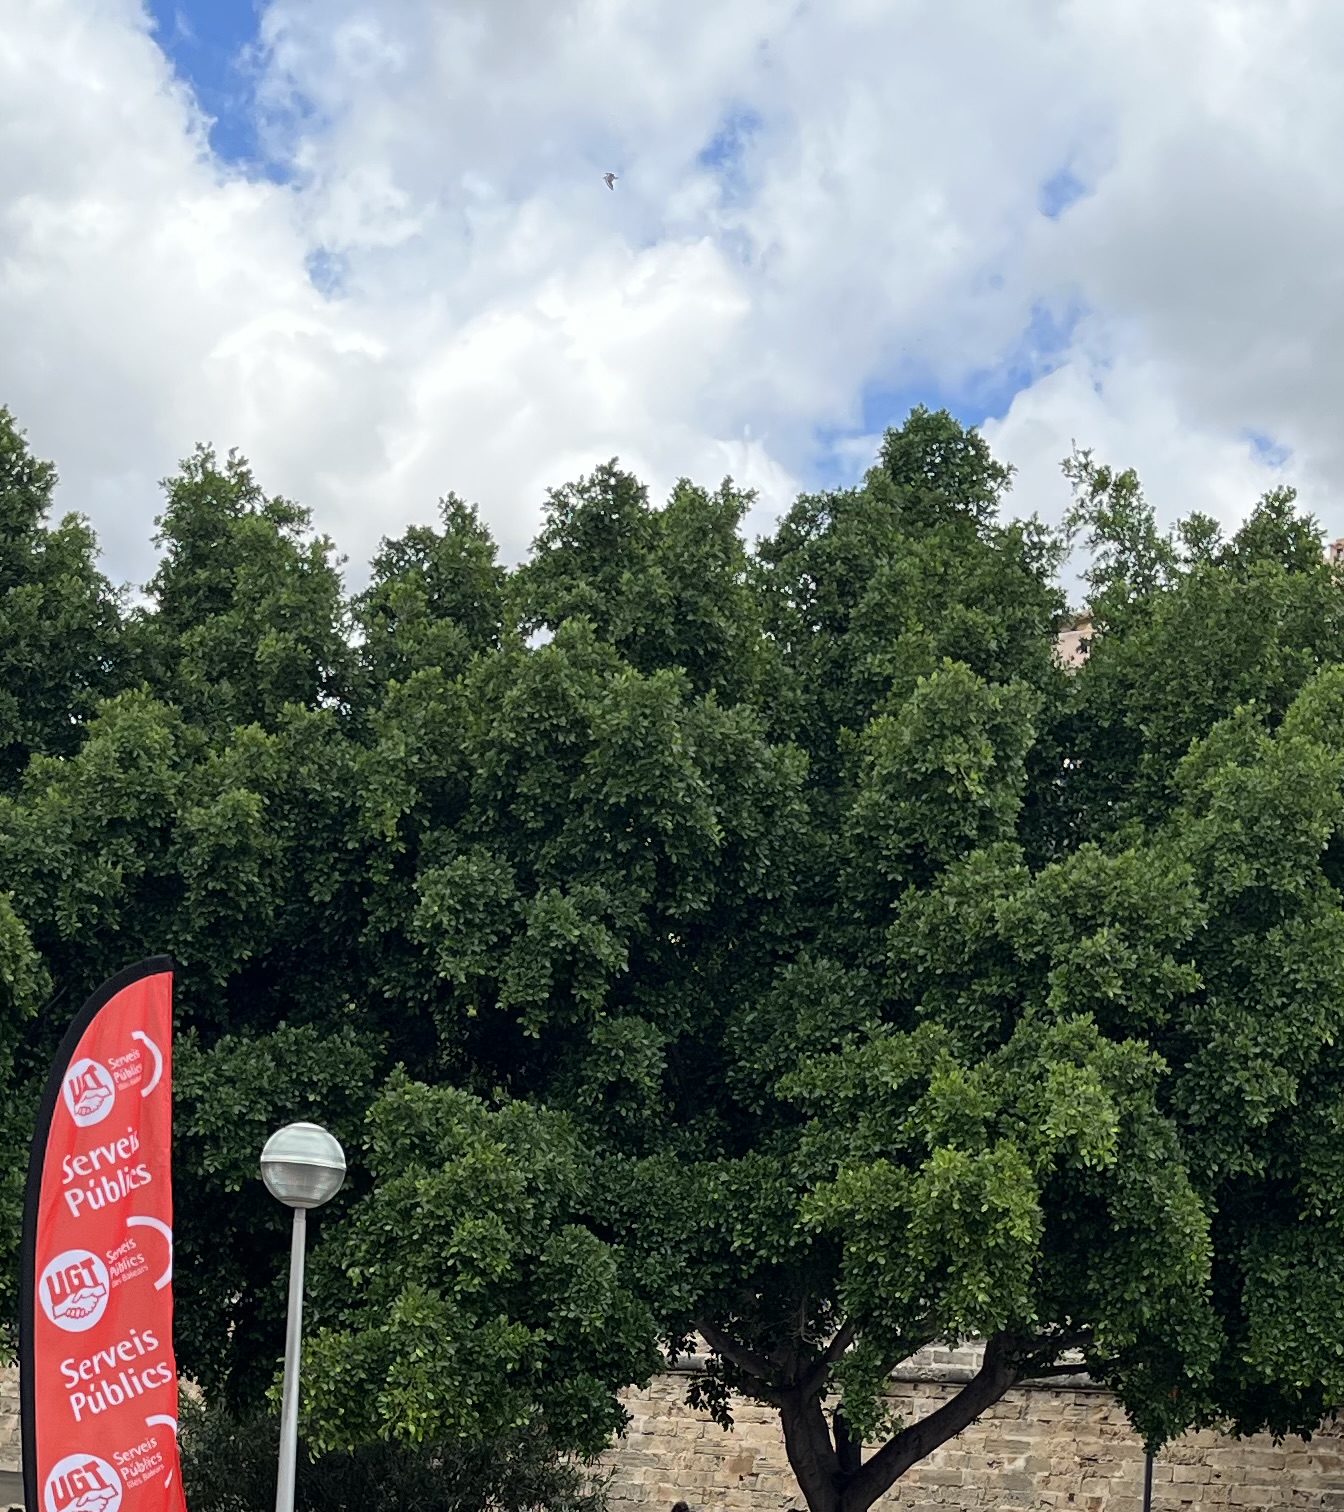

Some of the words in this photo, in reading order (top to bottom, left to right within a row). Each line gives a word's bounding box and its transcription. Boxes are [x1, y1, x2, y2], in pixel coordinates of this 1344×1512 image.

[62, 1127, 140, 1184] Serveis
[64, 1163, 152, 1218] Públics
[46, 1256, 96, 1297] UGT
[60, 1328, 159, 1389] Serveis
[70, 1361, 173, 1422] Públics
[112, 1437, 158, 1466] Serveis
[120, 1452, 163, 1481] Públics
[51, 1460, 108, 1504] UGT
